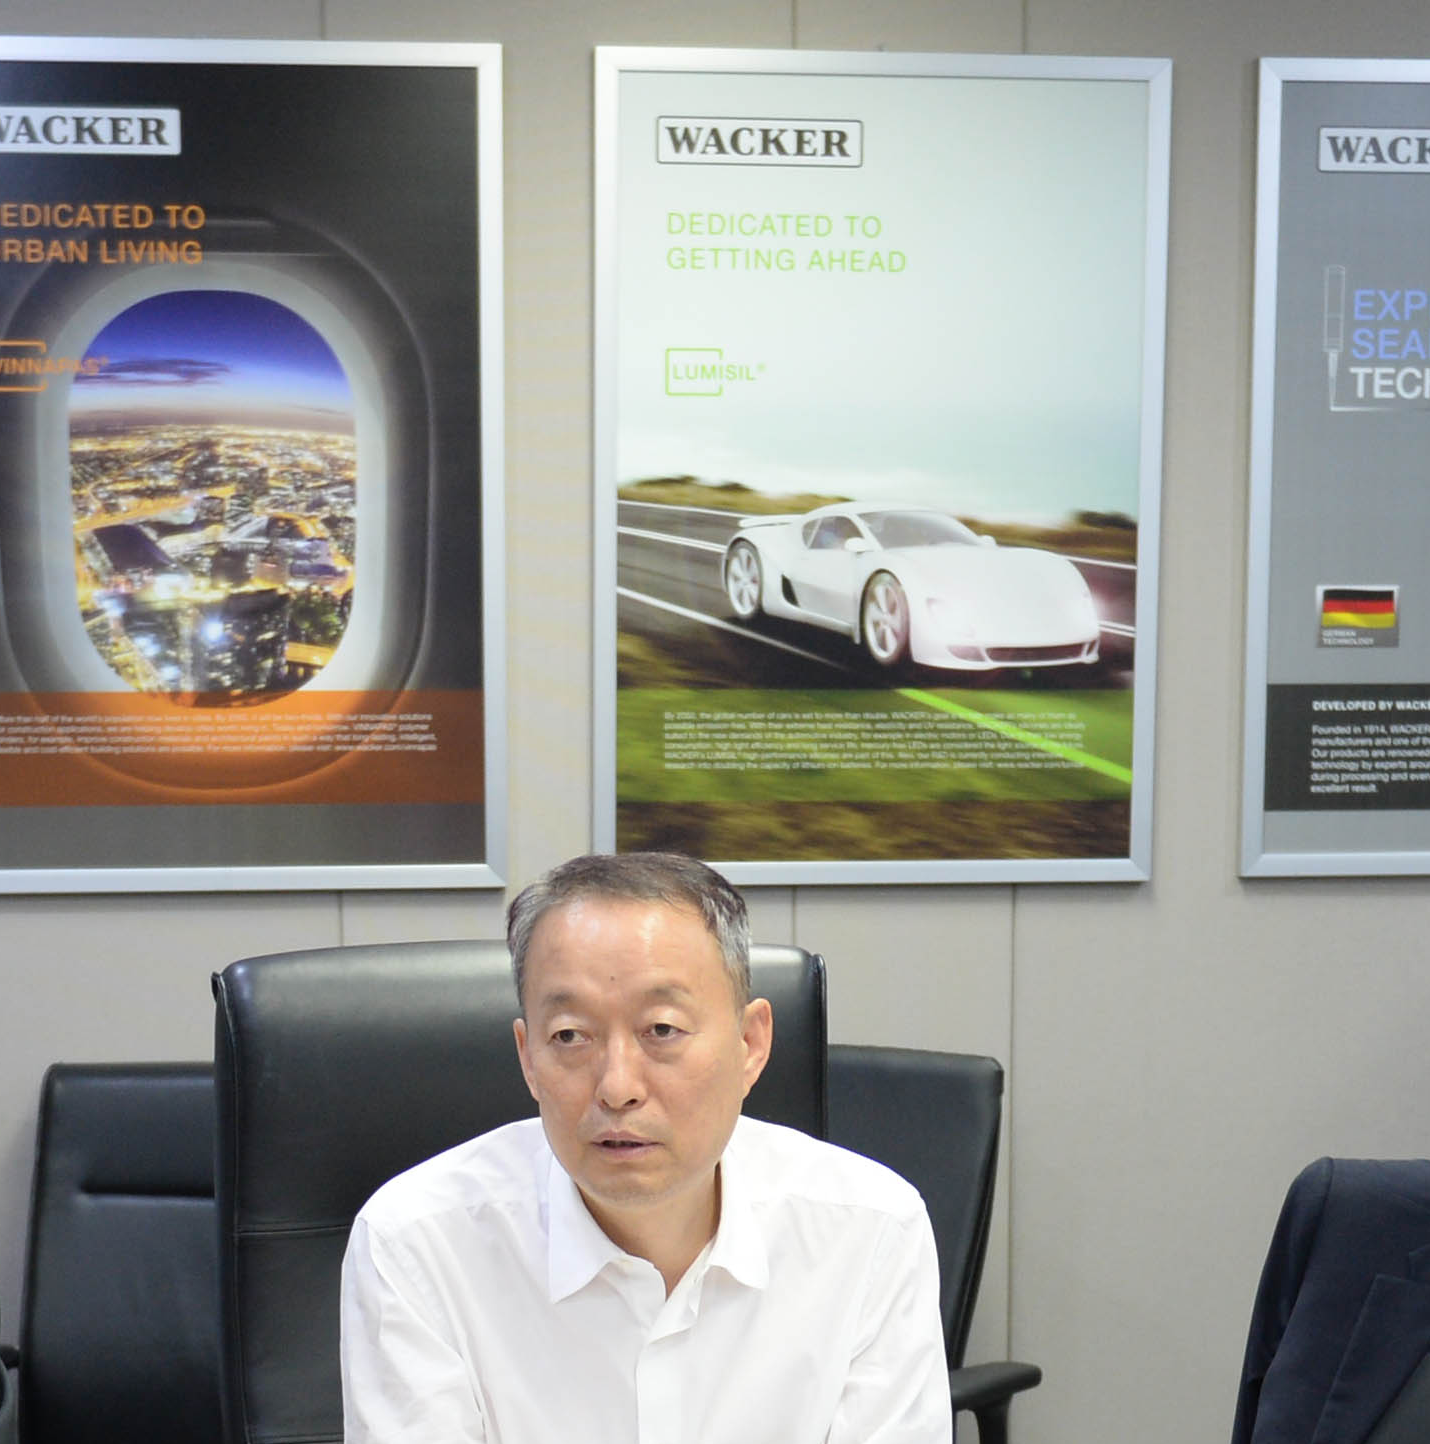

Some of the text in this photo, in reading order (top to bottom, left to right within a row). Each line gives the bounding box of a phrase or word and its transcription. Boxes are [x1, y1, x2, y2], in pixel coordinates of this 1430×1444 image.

[665, 126, 851, 158] WACKER
[164, 204, 205, 230] TO
[667, 212, 882, 239] DEDICATED TO
[100, 240, 203, 265] LIVING
[667, 248, 907, 273] GETTING AHEAD
